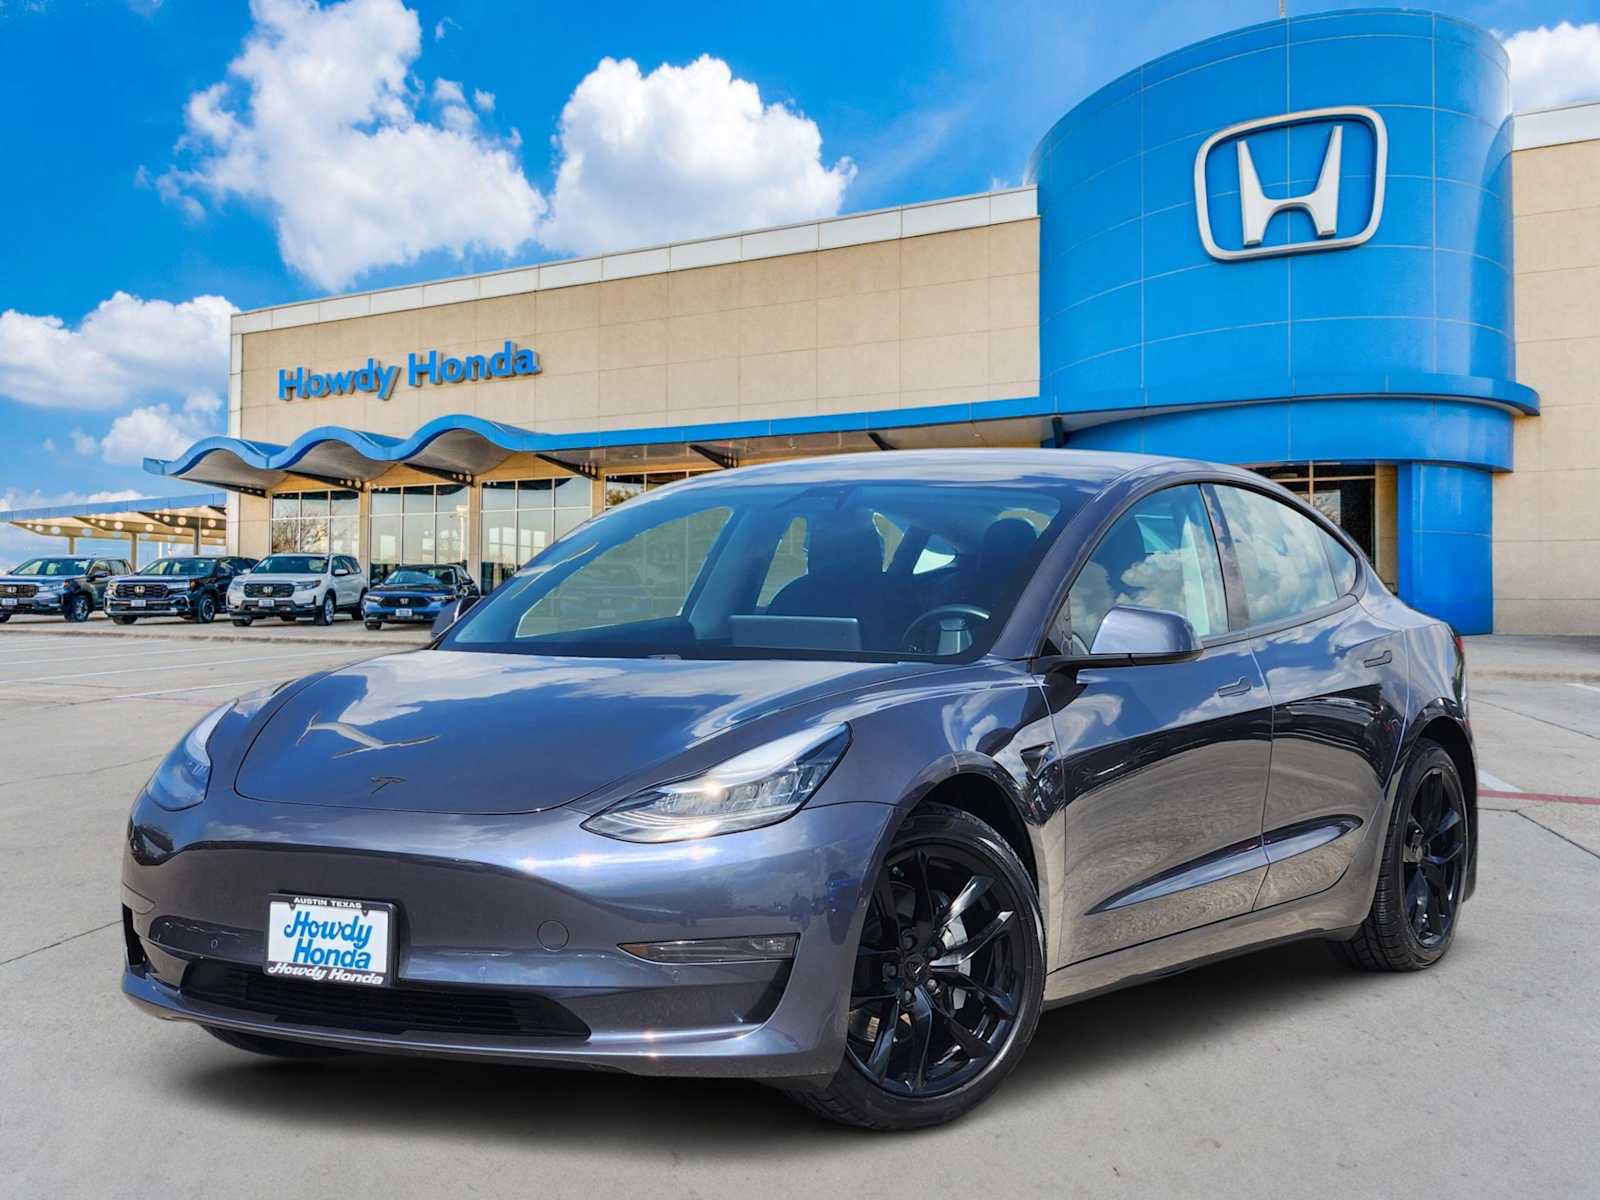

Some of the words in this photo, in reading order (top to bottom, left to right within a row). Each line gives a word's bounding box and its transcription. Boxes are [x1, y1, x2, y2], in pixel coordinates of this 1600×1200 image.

[279, 358, 401, 401] Howdy
[408, 340, 542, 388] Honda
[294, 897, 327, 906] AUSTIN
[331, 901, 362, 909] TEXAS
[284, 911, 373, 949] Howdy
[293, 938, 371, 969] Honda
[267, 963, 327, 980] Howdy
[328, 968, 384, 984] Honda
